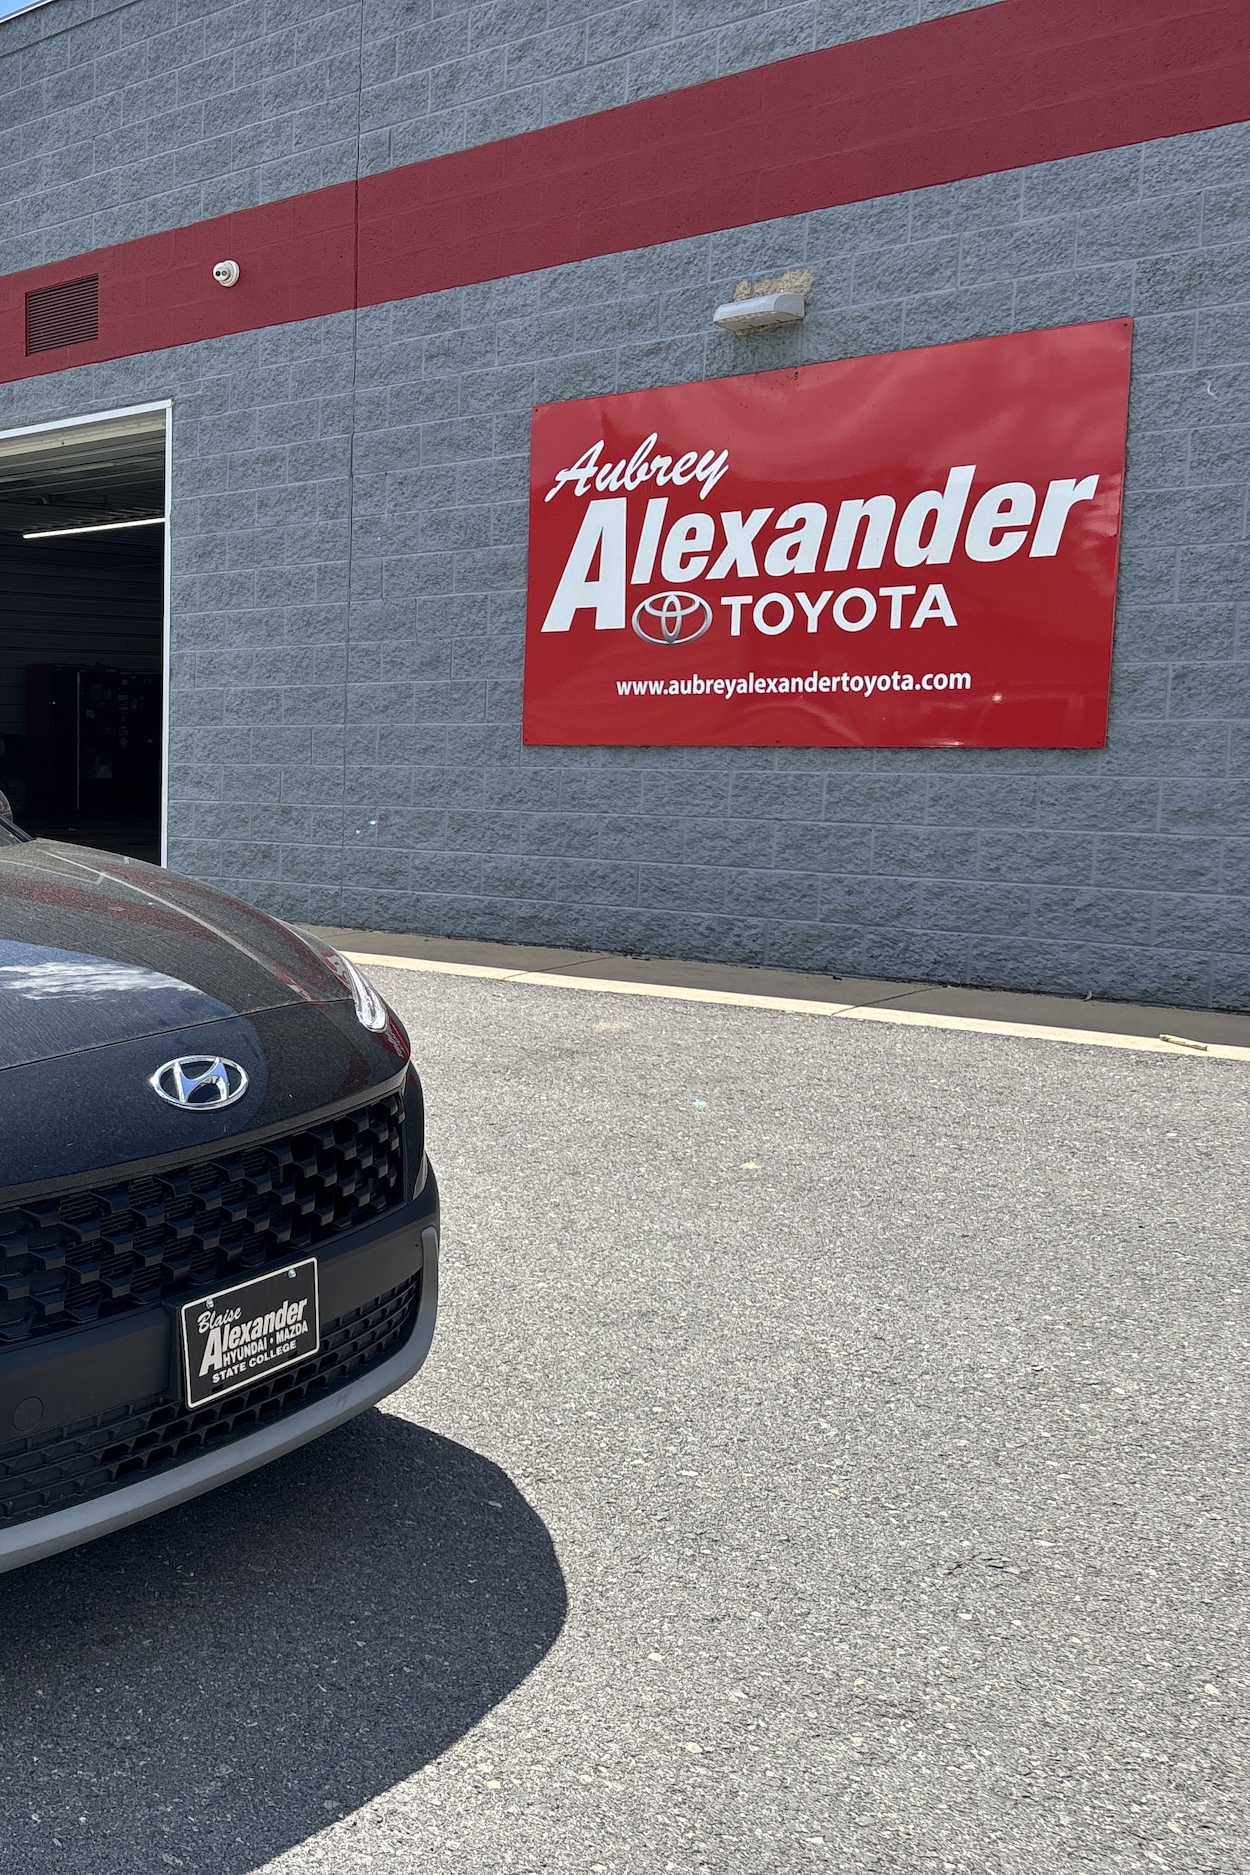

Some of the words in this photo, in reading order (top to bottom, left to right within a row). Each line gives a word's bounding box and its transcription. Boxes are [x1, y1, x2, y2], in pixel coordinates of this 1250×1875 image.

[545, 433, 729, 503] Aubrey
[541, 466, 1100, 634] Alexander
[721, 584, 958, 637] TOYOTA
[616, 670, 972, 700] www.aubreyalexandertoyota.com
[197, 1307, 242, 1334] Blaise
[199, 1298, 308, 1377] Alexander
[223, 1335, 268, 1367] HYUNDAI
[276, 1320, 309, 1345] MAZDA
[212, 1361, 246, 1383] STATE
[249, 1339, 297, 1367] COLLEGE
